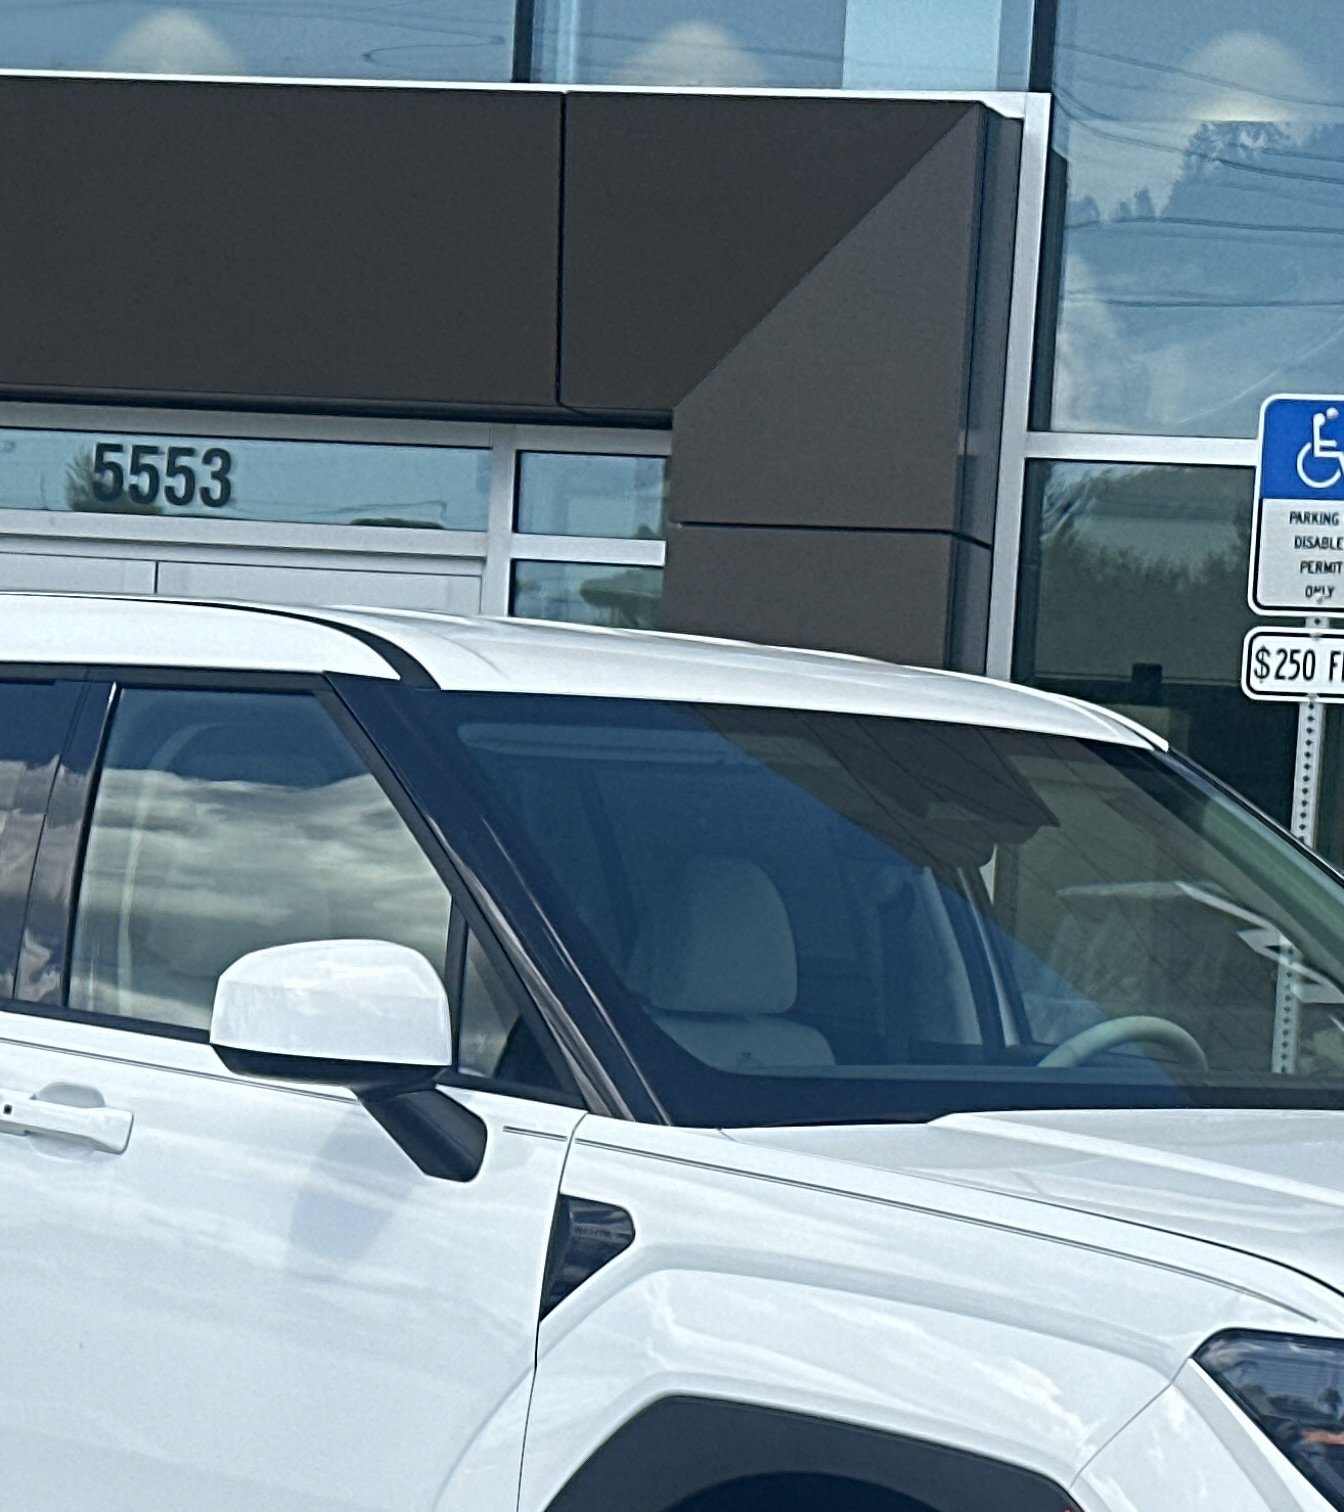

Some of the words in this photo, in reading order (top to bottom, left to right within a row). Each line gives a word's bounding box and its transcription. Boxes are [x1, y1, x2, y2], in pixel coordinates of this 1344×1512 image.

[92, 442, 232, 508] 5553
[1289, 511, 1340, 526] PARKING
[1300, 560, 1344, 574] PERMIT
[1253, 644, 1317, 684] $250
